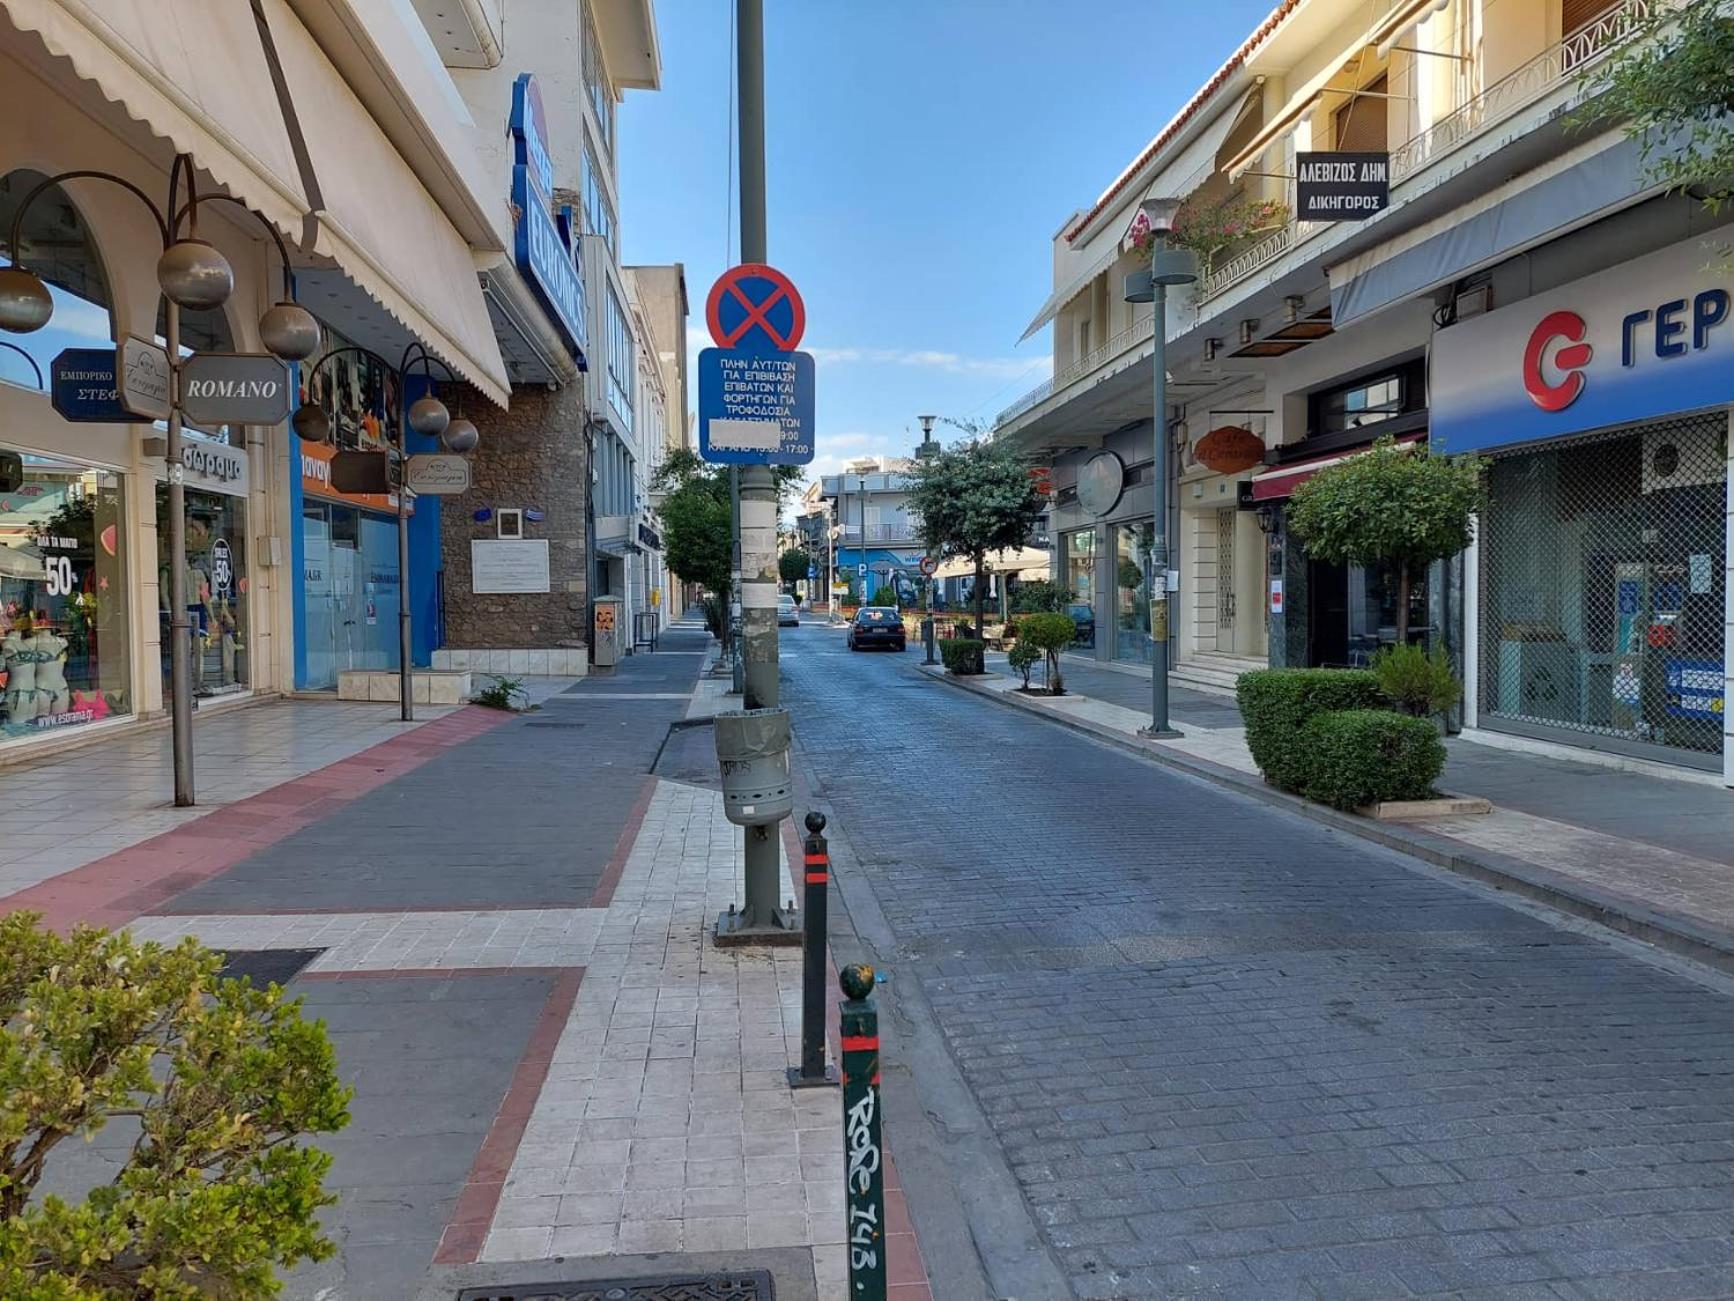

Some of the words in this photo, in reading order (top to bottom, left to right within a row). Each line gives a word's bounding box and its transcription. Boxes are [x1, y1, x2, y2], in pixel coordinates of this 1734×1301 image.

[1299, 162, 1357, 182] ΑΛΕΒΙΖΟΣ
[1308, 195, 1380, 209] ΔΙΚΗΓΟΡΟΣ
[720, 359, 748, 369] ΠΛΗΝ
[752, 360, 796, 371] ΑΥΤ/ΤΩΝ
[60, 370, 113, 381] ΕΜΠΟΡΙΚΟ
[723, 370, 740, 380] ΓΙΑ
[744, 371, 795, 382] ΕΠΙΒΙΒΑΣΗ
[187, 379, 277, 399] ROMANO
[724, 382, 774, 392] ΕΠΙΒΑΤΩΝ
[777, 384, 794, 393] ΚΑΙ
[723, 394, 777, 404] ΦΟΡΤΗΓΩΝ
[780, 395, 796, 405] ΓΙΑ
[725, 405, 791, 416] ΤΡΟΦΟΔΟΣΙΑ
